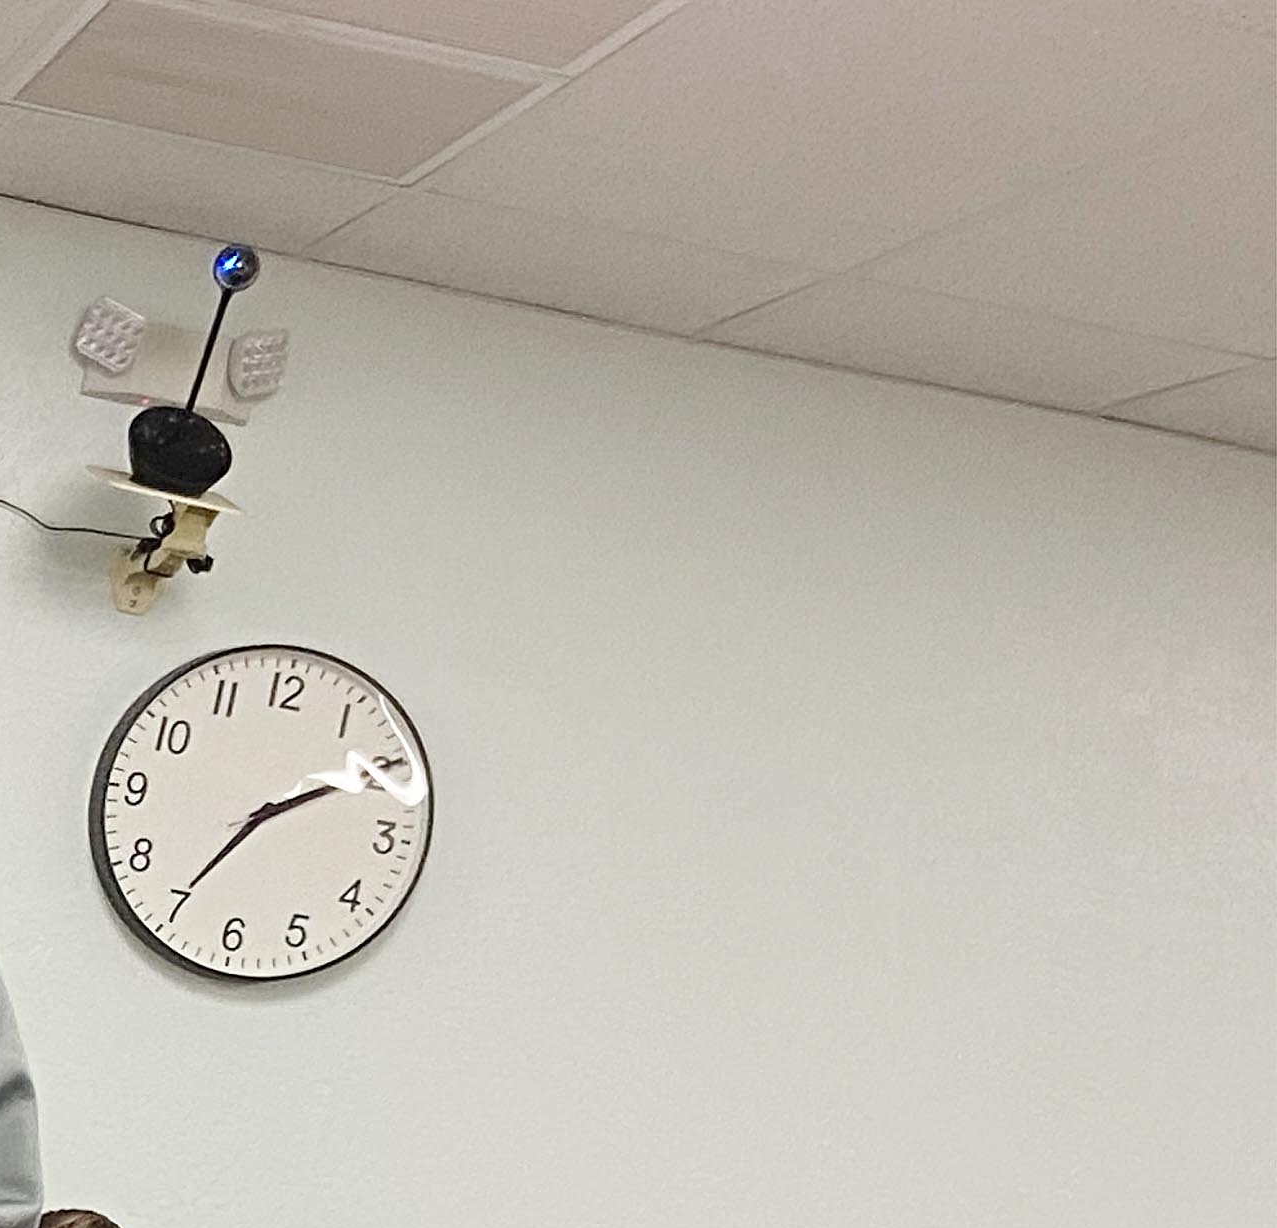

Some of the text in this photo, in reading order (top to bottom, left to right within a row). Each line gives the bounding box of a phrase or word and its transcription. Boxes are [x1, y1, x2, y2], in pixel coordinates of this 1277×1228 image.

[212, 679, 238, 718] 11
[268, 671, 306, 712] 12
[155, 715, 191, 755] 10
[338, 703, 351, 739] 1
[124, 771, 148, 807] 9
[129, 837, 153, 873] 8
[372, 819, 397, 855] 3
[169, 888, 192, 924] 7
[338, 879, 362, 913] 4
[222, 917, 246, 952] 6
[285, 913, 310, 948] 5
